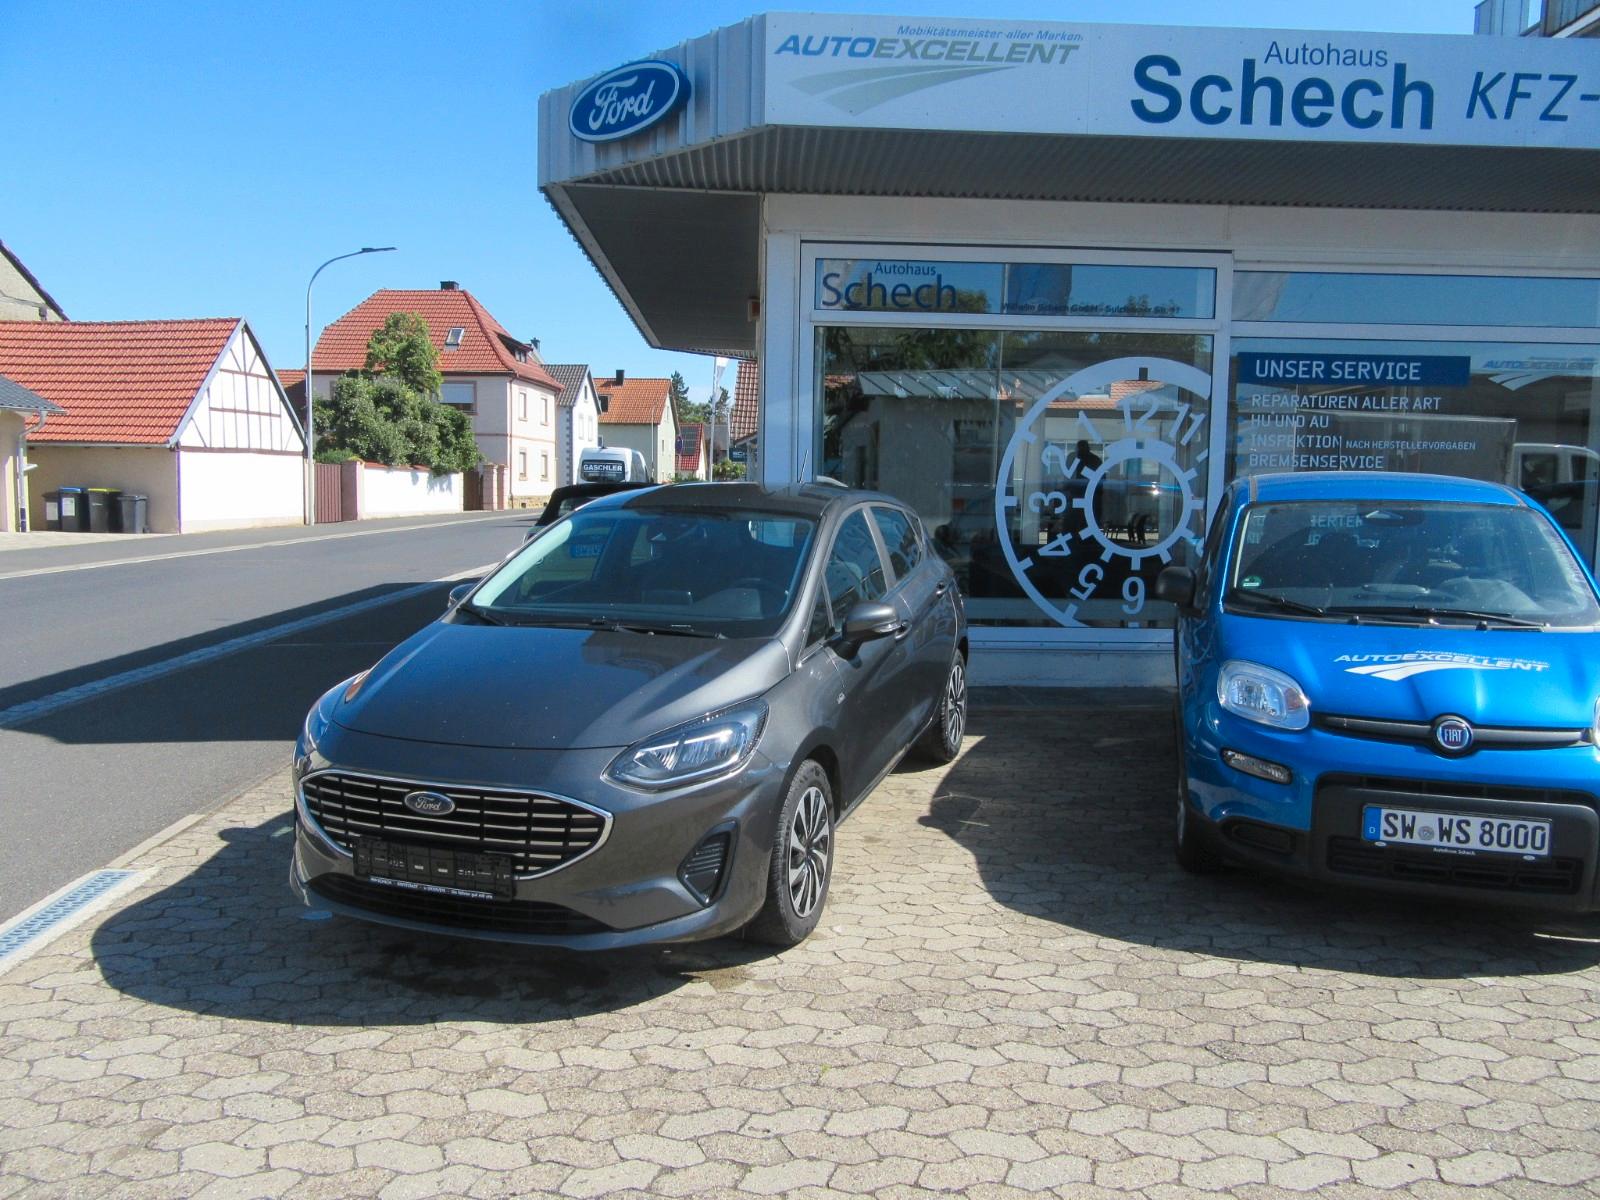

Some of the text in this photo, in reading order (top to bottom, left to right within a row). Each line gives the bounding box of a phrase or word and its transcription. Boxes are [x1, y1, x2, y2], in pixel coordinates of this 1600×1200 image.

[1006, 31, 1034, 41] aller
[774, 34, 1080, 65] AUTOEXCELLENT
[1264, 40, 1388, 68] Autohaus
[1130, 54, 1434, 131] Schech
[588, 75, 656, 131] Ford
[874, 262, 937, 276] Autohaus
[821, 272, 957, 308] Schech
[1255, 359, 1422, 380] UNSER SERVICE
[1251, 394, 1441, 411] REPARATUREN ALLER ART
[1251, 414, 1329, 428] HU UND AU
[1251, 434, 1476, 450] INSPEKTION NACH HERSTELLERVORGABEN
[1250, 454, 1384, 469] BREMSENSERVICE
[1028, 491, 1067, 514] 3
[1037, 532, 1073, 557] 4
[1333, 653, 1550, 673] AUTOEXCELLENT
[1444, 729, 1463, 743] FIAT
[414, 798, 441, 811] Ford
[1383, 812, 1546, 851] SW WS 8000
